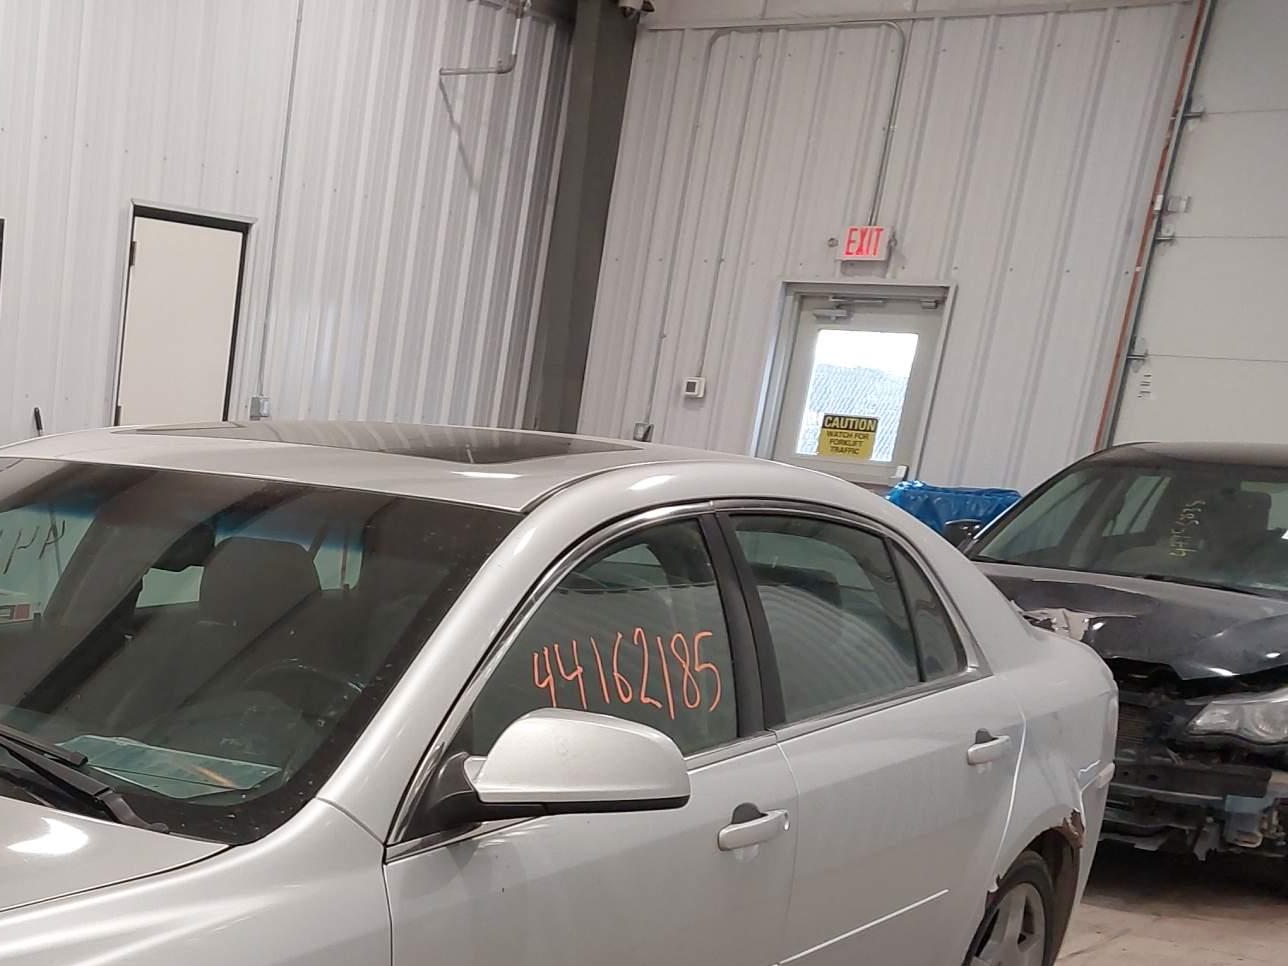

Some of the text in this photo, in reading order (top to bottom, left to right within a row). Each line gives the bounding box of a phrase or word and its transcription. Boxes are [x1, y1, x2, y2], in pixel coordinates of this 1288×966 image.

[844, 227, 884, 256] EXIT
[823, 415, 877, 431] CAUTION
[826, 430, 870, 440] WATCH FOR
[829, 438, 865, 448] FORKLIFT
[829, 445, 861, 455] TRAFFIC
[532, 626, 721, 720] 44162185
